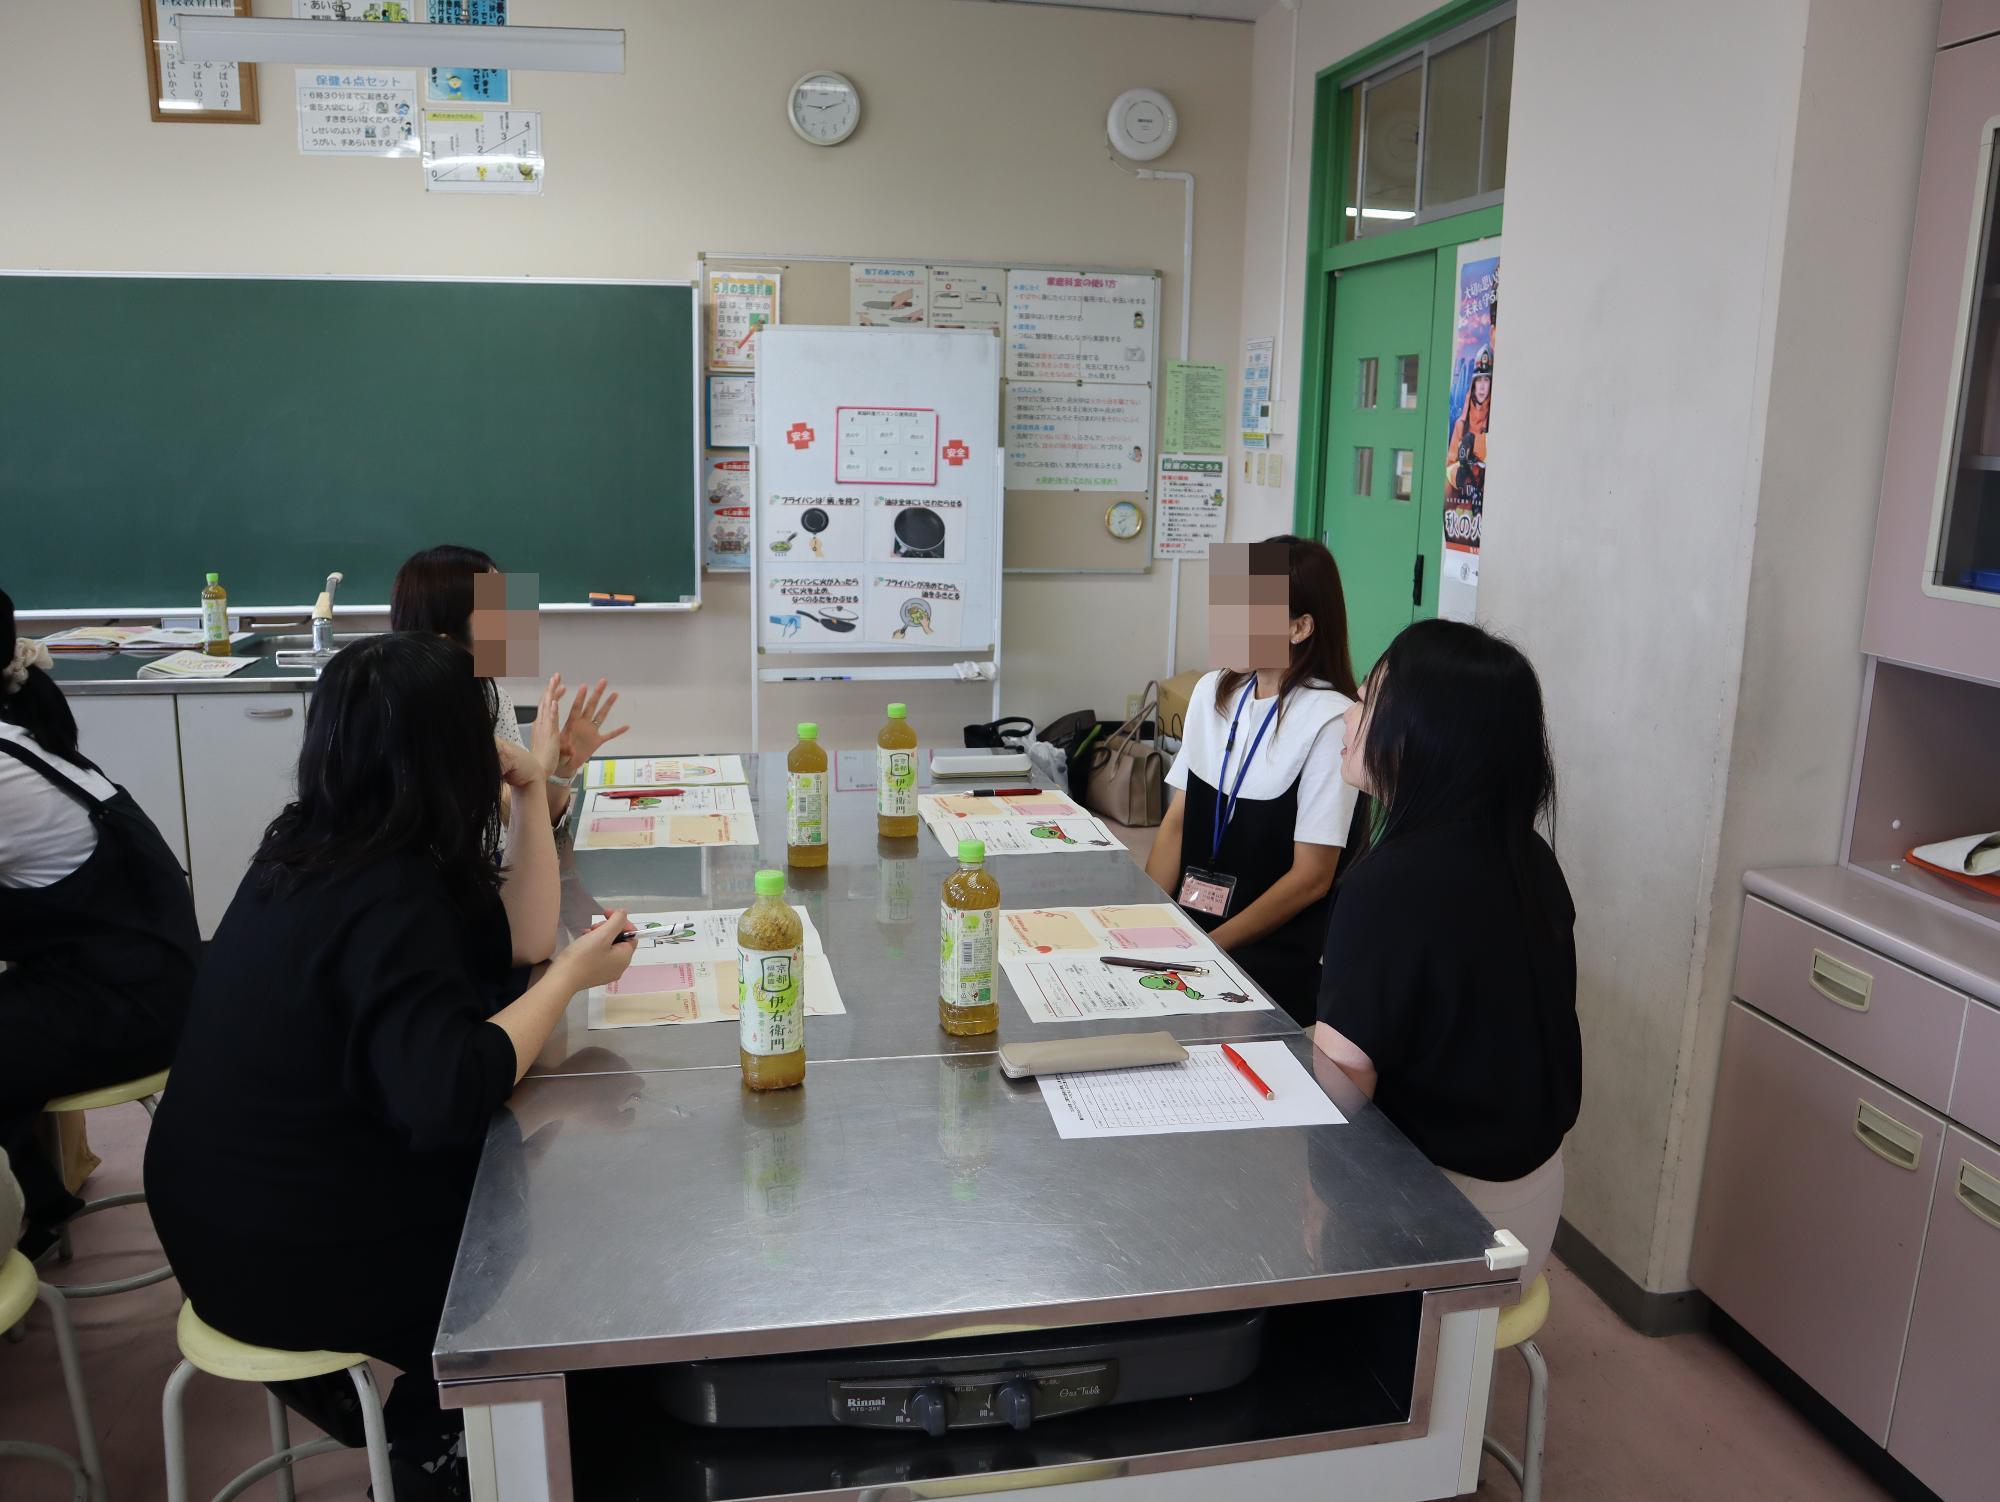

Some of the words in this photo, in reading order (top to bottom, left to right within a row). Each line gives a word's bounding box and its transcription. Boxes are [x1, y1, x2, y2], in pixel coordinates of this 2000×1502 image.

[525, 120, 531, 129] 4
[501, 132, 507, 140] 3
[477, 145, 484, 154] 2
[431, 169, 438, 178] 0
[791, 431, 811, 441] 安全
[947, 449, 967, 458] 安全
[776, 963, 788, 985] 京都
[768, 995, 786, 1051] 伊右衛門
[1059, 1388, 1078, 1398] Gas
[1081, 1384, 1102, 1397] Table
[847, 1396, 886, 1407] Rinnai
